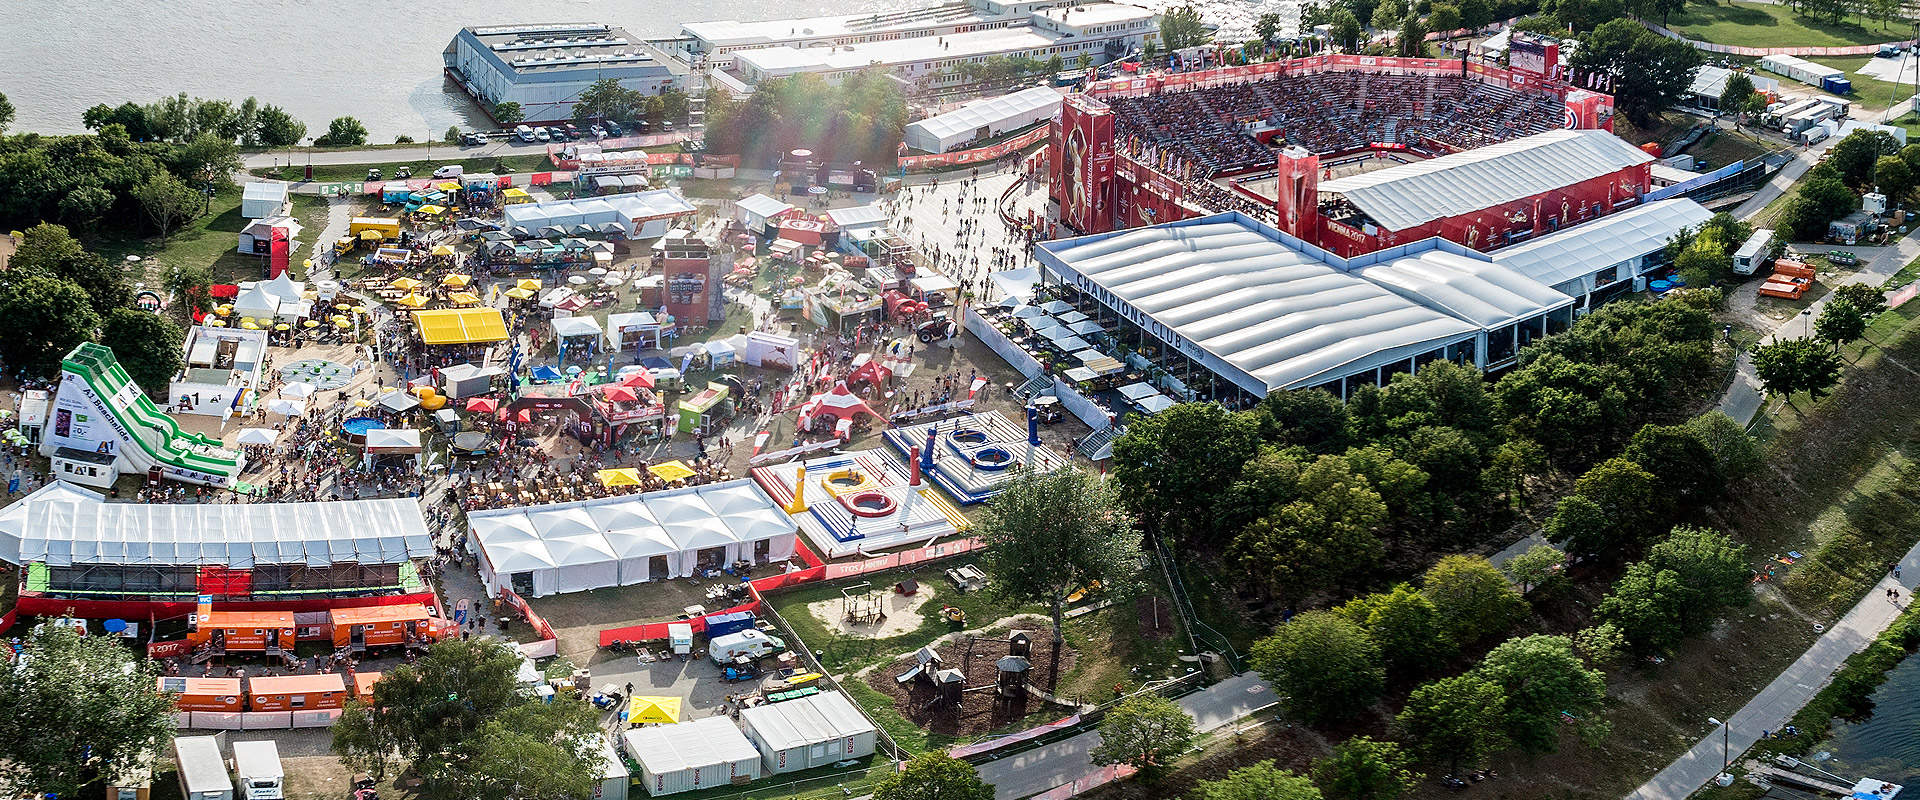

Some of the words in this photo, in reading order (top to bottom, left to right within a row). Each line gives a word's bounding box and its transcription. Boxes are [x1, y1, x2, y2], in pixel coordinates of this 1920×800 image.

[1327, 220, 1350, 238] VIENNA
[1350, 230, 1366, 243] 2017
[1076, 273, 1145, 327] CHAMPIONS
[1151, 321, 1181, 348] CLUB
[179, 392, 200, 411] A1
[210, 394, 222, 403] A1
[83, 388, 95, 402] A1
[93, 399, 130, 442] Beachslide
[96, 440, 114, 453] A1
[74, 466, 86, 475] A1
[157, 644, 178, 653] 2017
